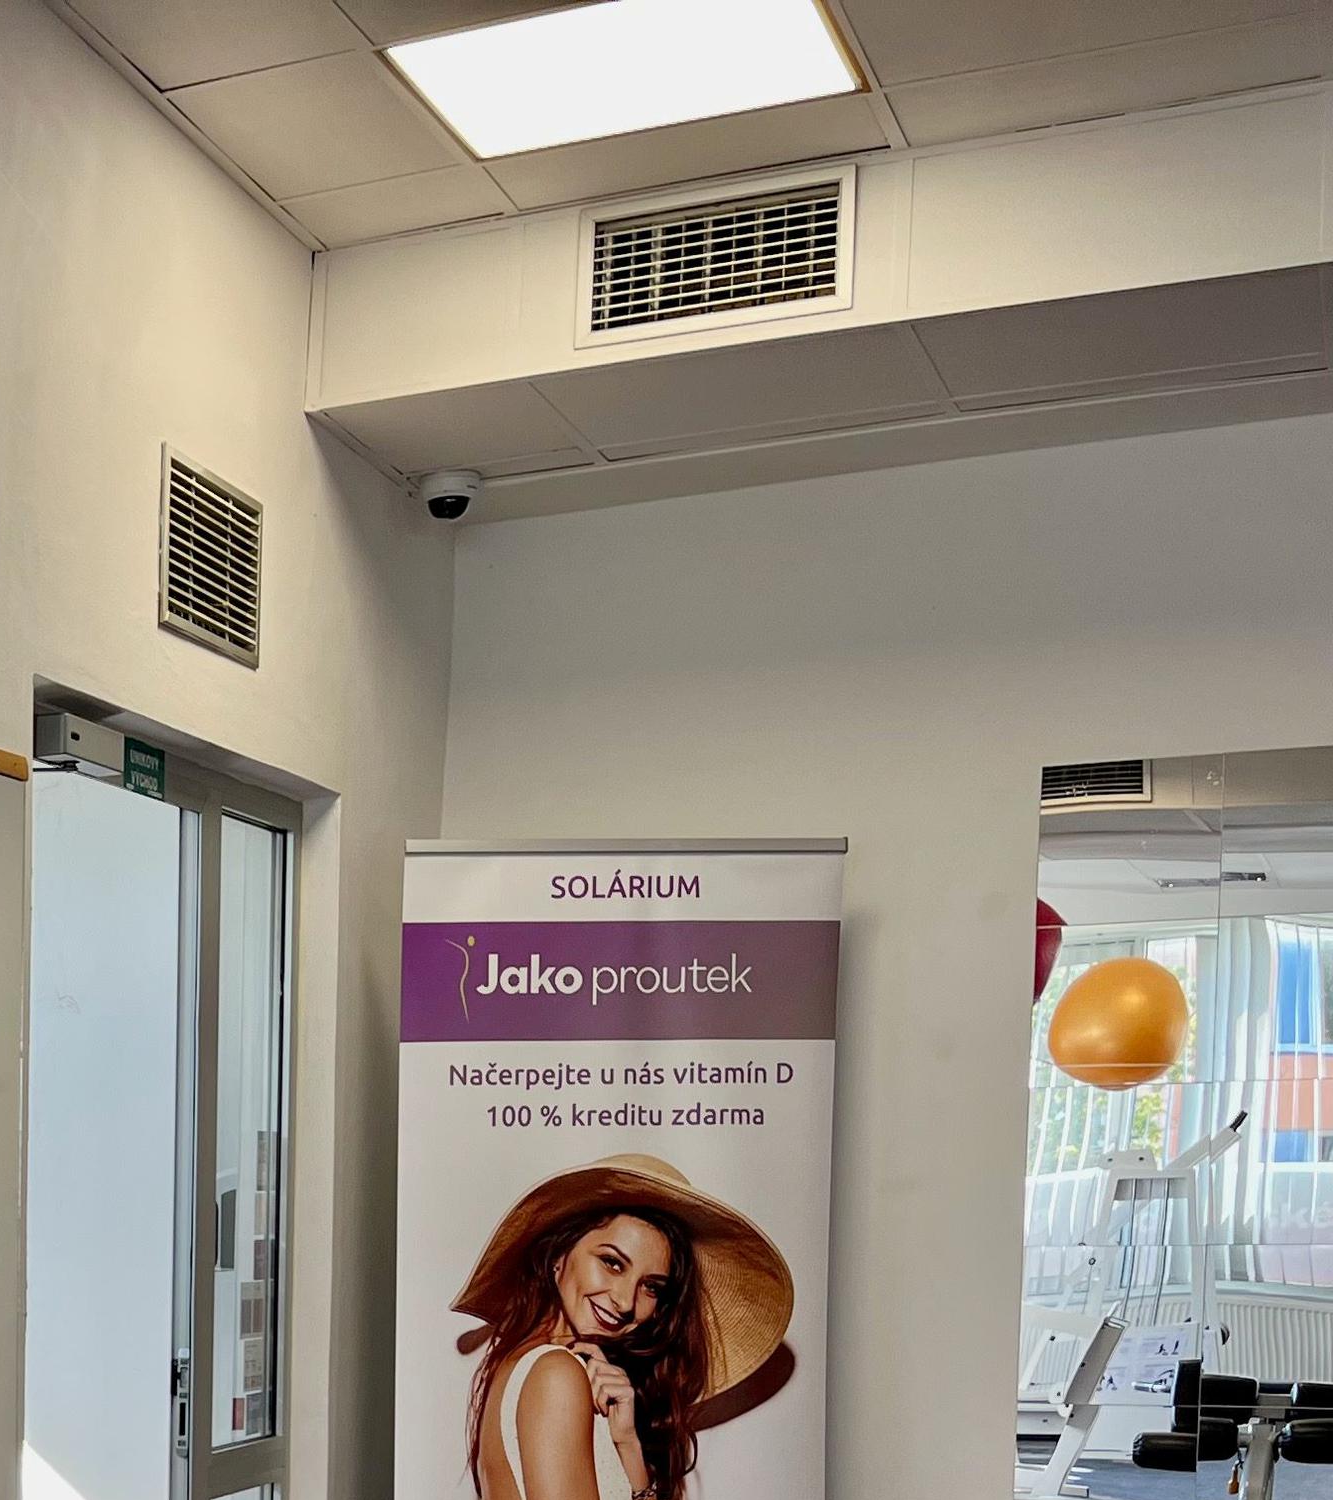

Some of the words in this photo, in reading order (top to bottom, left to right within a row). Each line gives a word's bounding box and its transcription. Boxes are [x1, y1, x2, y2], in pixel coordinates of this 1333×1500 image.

[550, 869, 702, 899] SOLÁRIUM
[475, 953, 584, 995] Jako
[591, 953, 753, 1006] proutek
[448, 1063, 592, 1090] Načerpejte
[600, 1068, 614, 1085] u
[624, 1062, 665, 1085] nás
[673, 1062, 768, 1085] vitamín
[776, 1063, 795, 1084] D
[486, 1105, 533, 1128] 100
[539, 1105, 564, 1127] %
[572, 1103, 664, 1127] kreditu
[671, 1104, 765, 1126] zdarma
